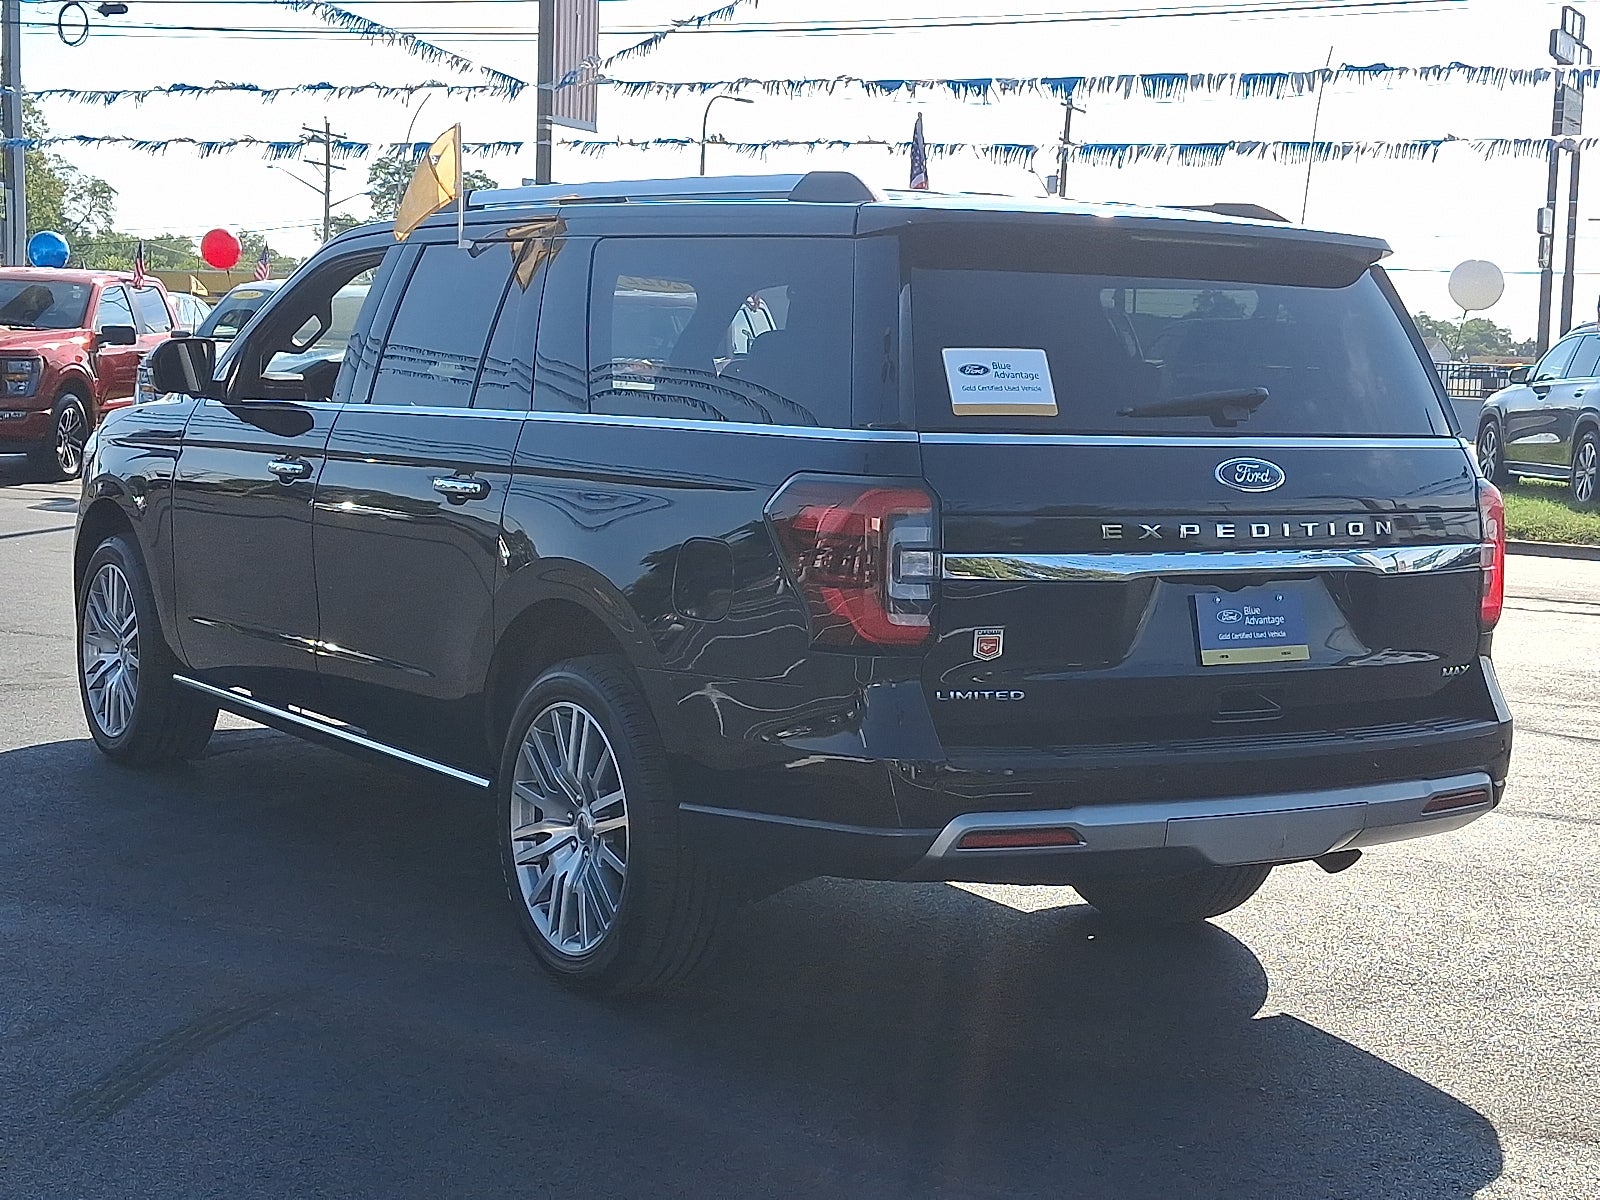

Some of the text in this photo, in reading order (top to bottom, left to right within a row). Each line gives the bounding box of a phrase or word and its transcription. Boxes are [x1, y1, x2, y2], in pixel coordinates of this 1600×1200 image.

[991, 361, 1012, 370] Blue
[994, 370, 1040, 381] Advantage
[1233, 462, 1273, 484] Ford
[1101, 520, 1392, 541] EXPEDITION
[1243, 606, 1261, 615] Blue
[1245, 615, 1285, 626] Advantage
[936, 690, 1025, 701] LIMITED
